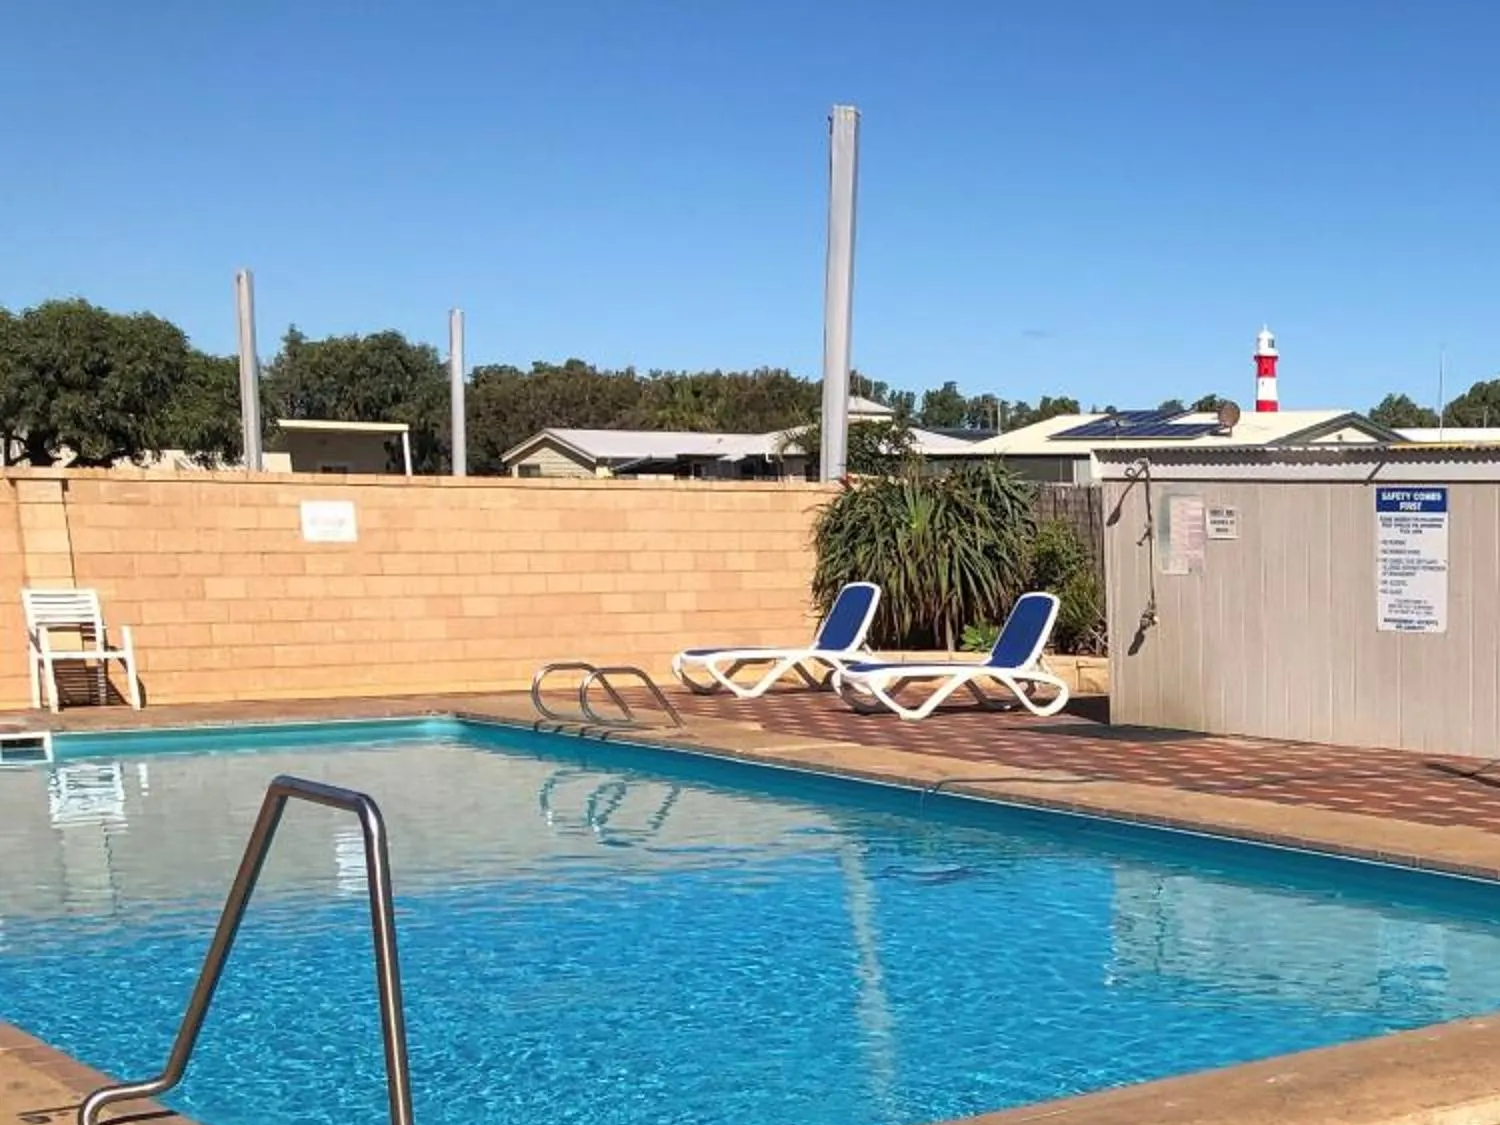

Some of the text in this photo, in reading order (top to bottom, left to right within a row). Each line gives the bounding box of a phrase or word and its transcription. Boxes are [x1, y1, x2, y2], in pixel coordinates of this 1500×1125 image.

[1381, 491, 1442, 501] SAFETY COMES
[1400, 502, 1422, 511] FIRST
